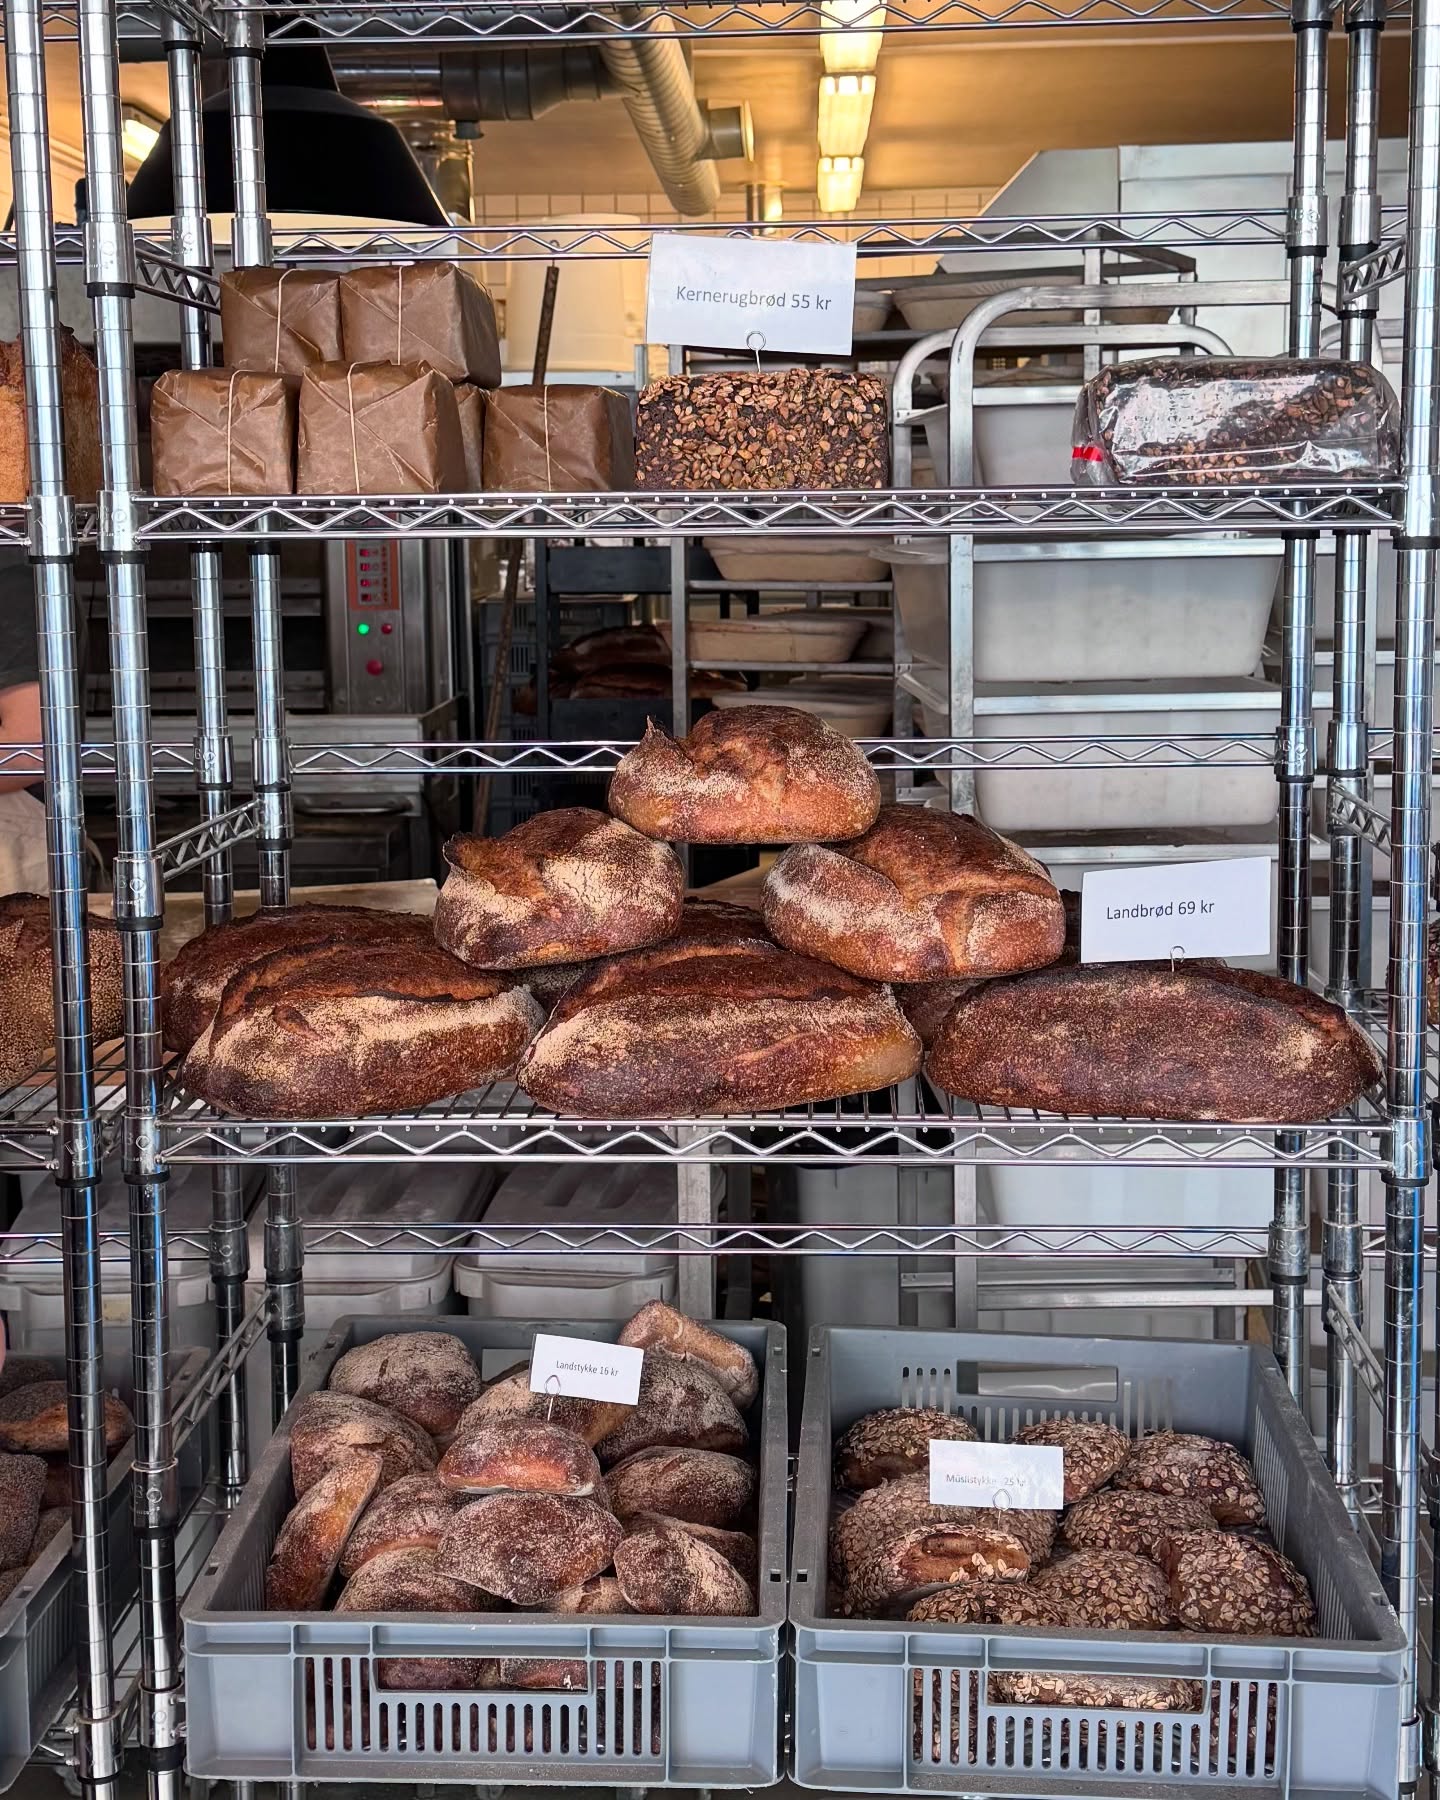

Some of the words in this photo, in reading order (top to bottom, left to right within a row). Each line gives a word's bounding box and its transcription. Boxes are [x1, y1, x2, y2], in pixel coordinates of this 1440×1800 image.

[677, 285, 786, 308] Kernerugbrød
[790, 293, 810, 308] 55
[816, 295, 832, 310] kr
[1107, 902, 1173, 919] Landbrød
[1178, 901, 1195, 915] 69
[1200, 900, 1215, 914] kr
[556, 1360, 598, 1374] Landstykke
[599, 1366, 609, 1376] 16
[610, 1368, 619, 1377] kr
